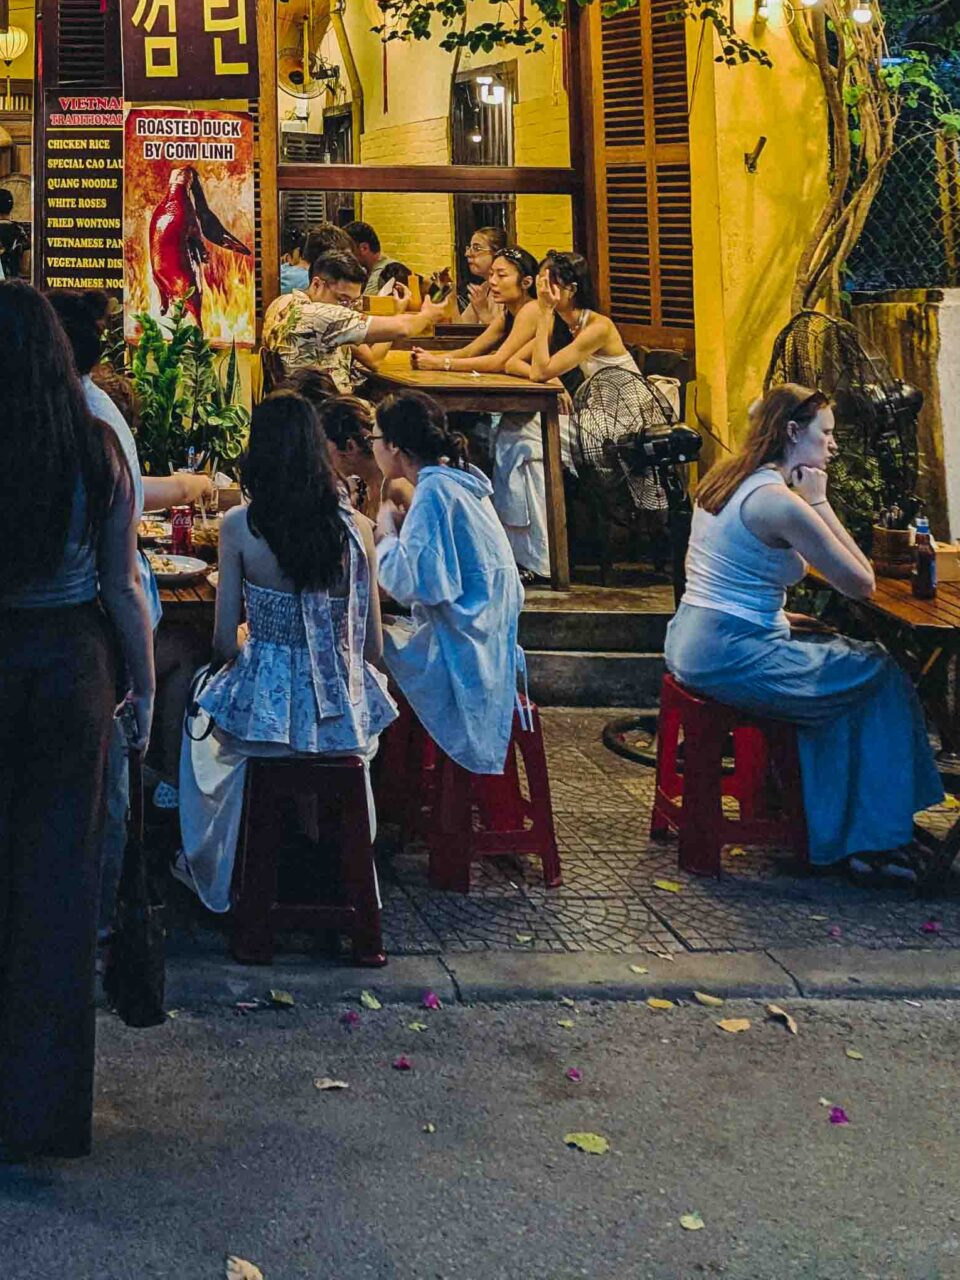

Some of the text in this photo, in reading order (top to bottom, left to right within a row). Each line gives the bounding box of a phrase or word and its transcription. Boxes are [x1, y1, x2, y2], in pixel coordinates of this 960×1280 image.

[137, 119, 240, 137] ROASTED DUCK
[47, 139, 110, 150] CHICKEN RICE
[145, 143, 233, 159] BY COM LINH
[47, 159, 123, 169] SPECIAL CAO LAU
[47, 178, 118, 190] QUANG NOODLE
[47, 198, 107, 209] WHITE ROSES
[47, 218, 120, 229] FRIED WONTONS
[47, 237, 104, 248] VIETNAMESE
[47, 257, 123, 269] VEGETARIAN DIS
[46, 277, 104, 288] VIETNAMESE
